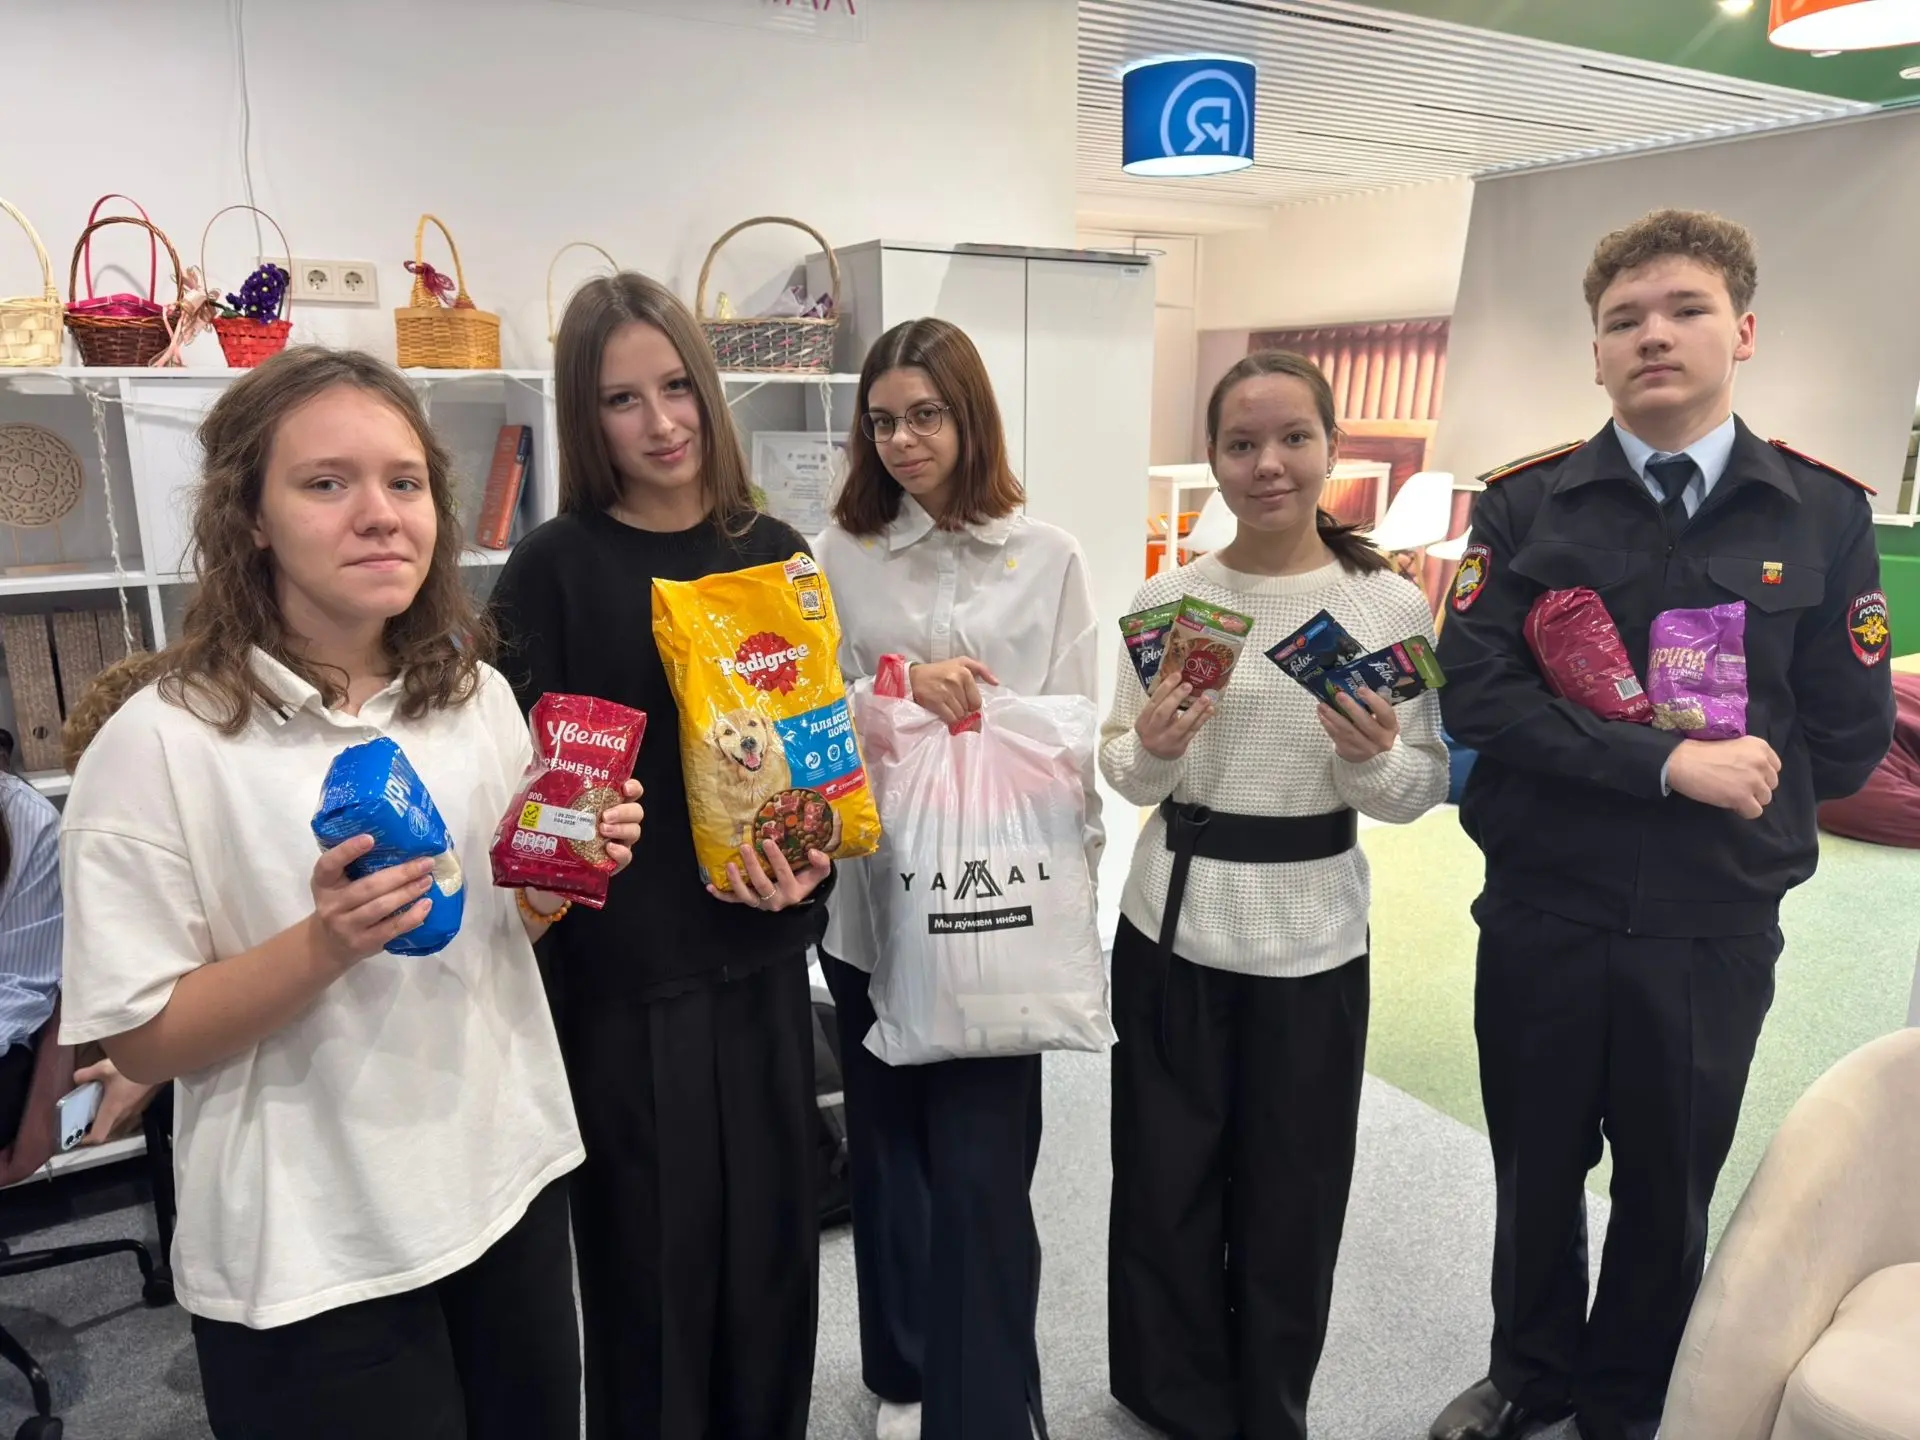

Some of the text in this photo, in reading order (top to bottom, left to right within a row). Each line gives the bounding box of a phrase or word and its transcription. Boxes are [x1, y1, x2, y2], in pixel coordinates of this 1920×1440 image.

[720, 643, 809, 676] Pedigree
[1185, 657, 1218, 678] ONE
[547, 720, 627, 752] Увелка
[810, 719, 833, 735] ДЛЯ
[934, 918, 952, 929] Мы
